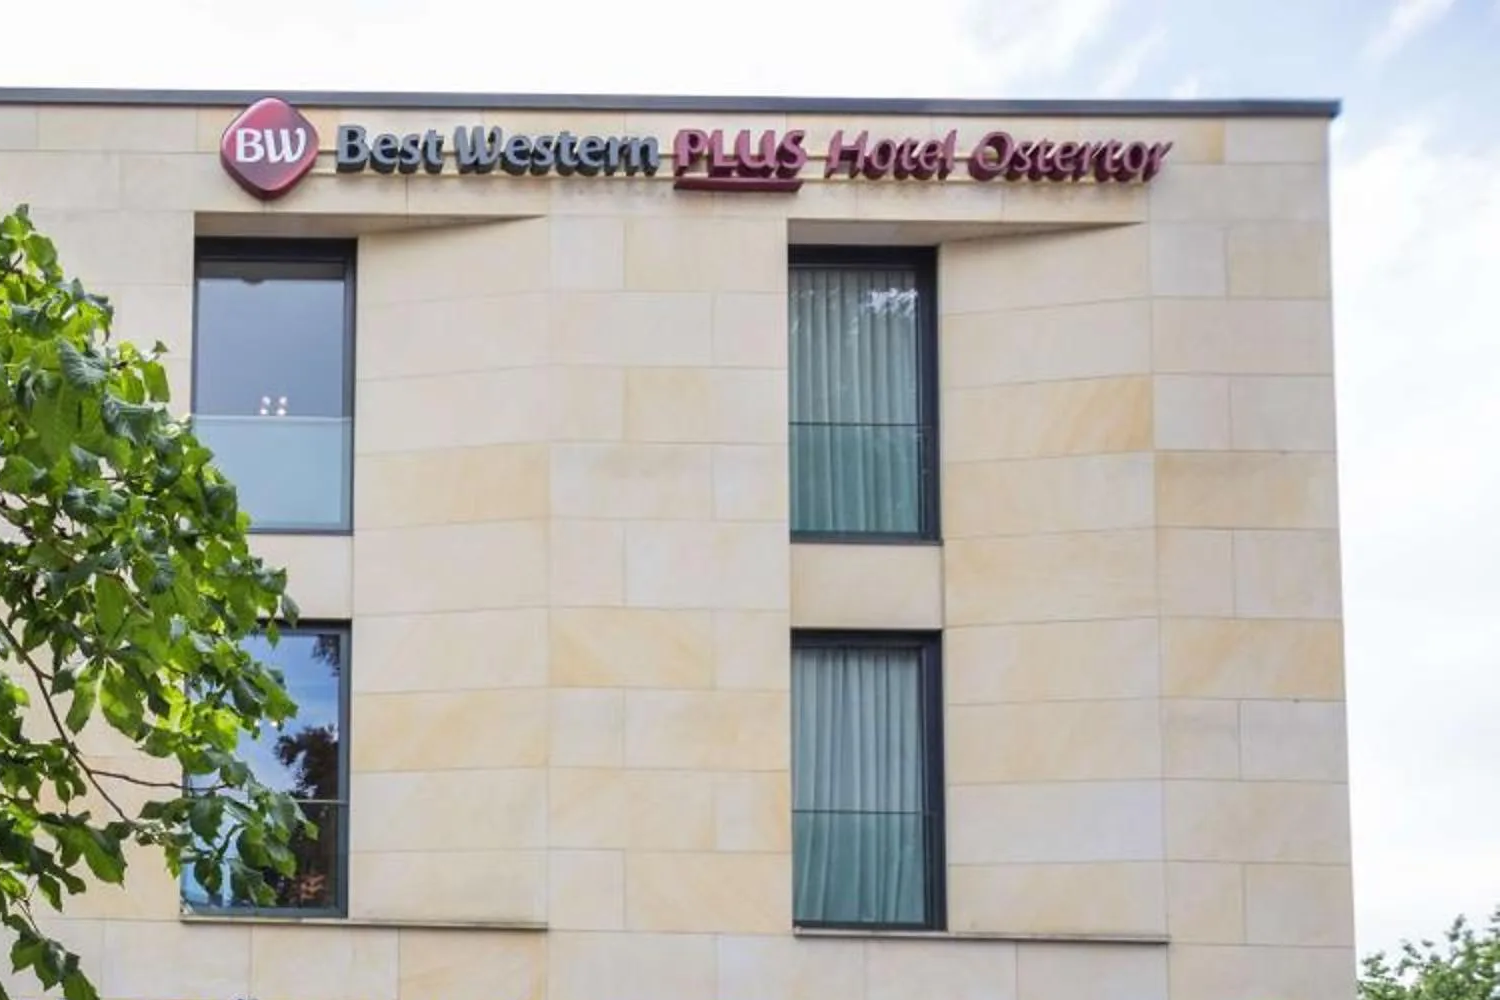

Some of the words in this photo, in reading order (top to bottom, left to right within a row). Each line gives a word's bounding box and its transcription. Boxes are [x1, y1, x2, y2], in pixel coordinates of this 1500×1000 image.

[235, 127, 307, 163] BW
[336, 124, 444, 174] Best
[454, 125, 661, 177] Western
[673, 129, 807, 178] PLUS
[824, 129, 957, 180] Hotel
[968, 130, 1173, 181] Ostertor
